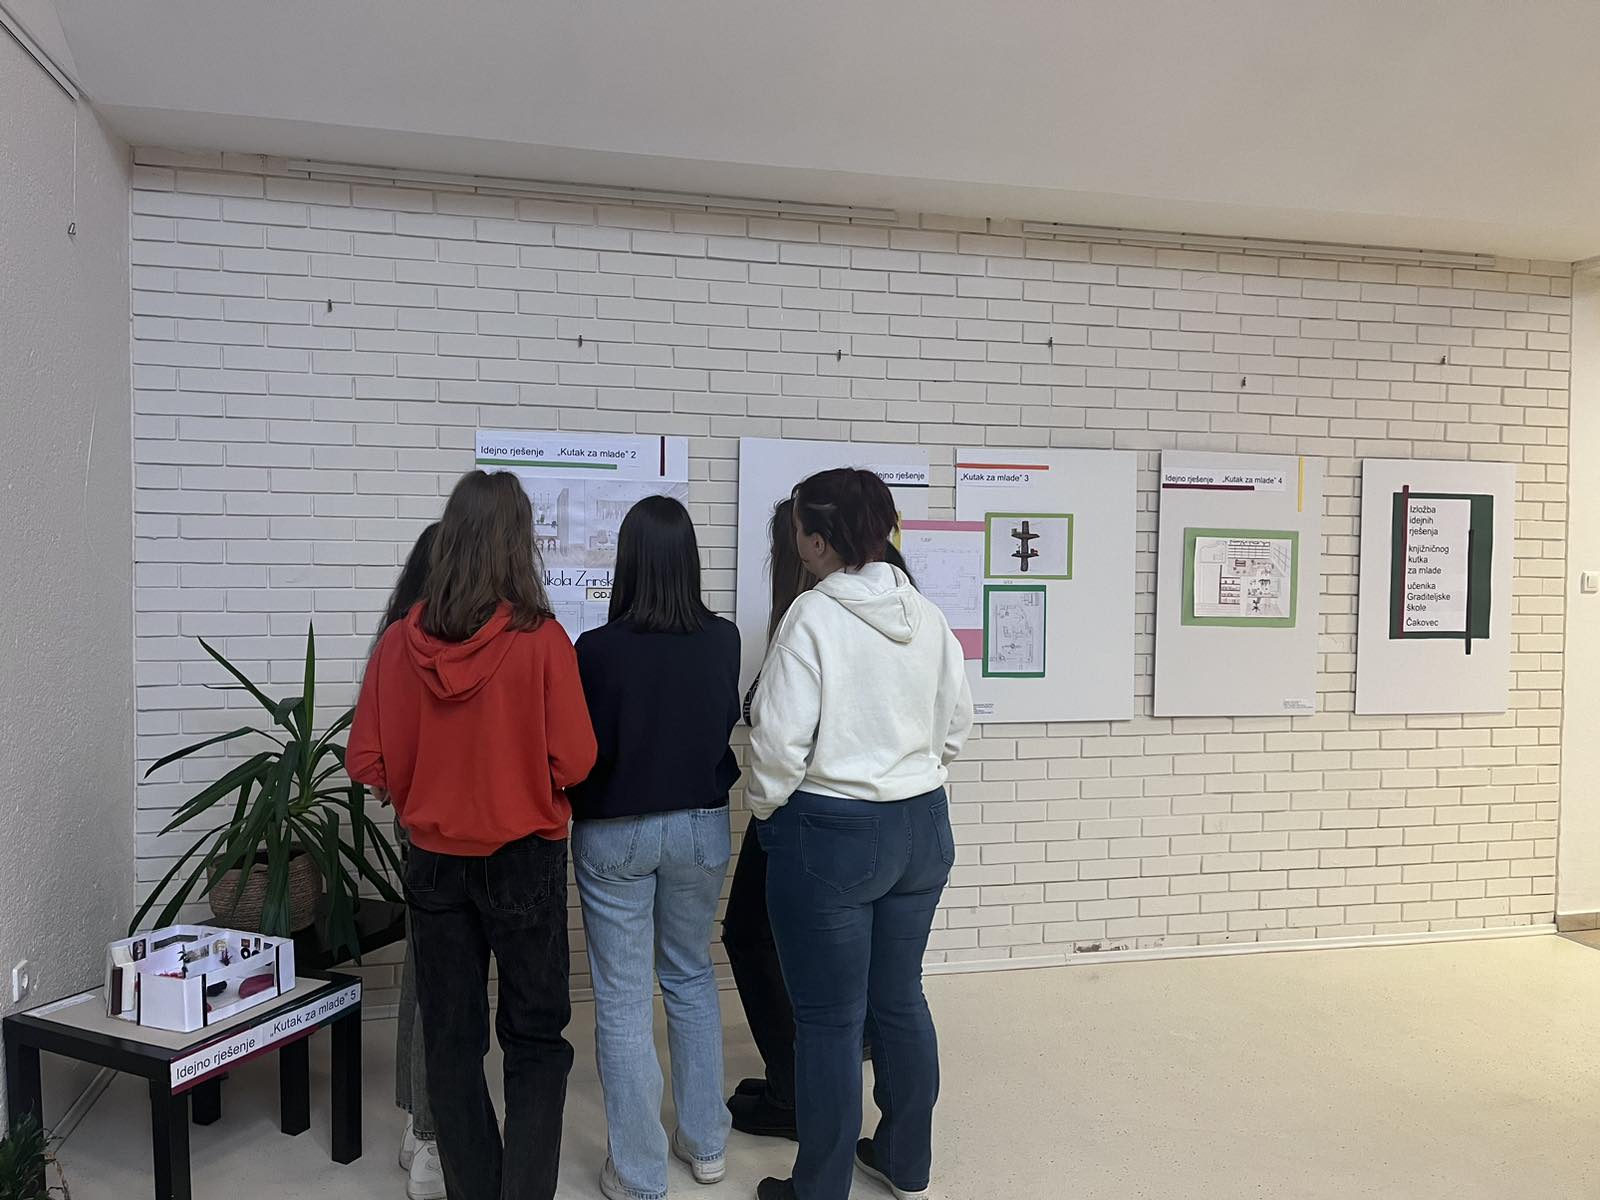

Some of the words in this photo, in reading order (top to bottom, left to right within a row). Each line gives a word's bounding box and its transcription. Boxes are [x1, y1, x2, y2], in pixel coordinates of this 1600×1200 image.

[480, 445, 508, 456] Idejno
[510, 446, 545, 457] rješenje
[587, 449, 598, 458] za
[631, 450, 637, 459] 2
[876, 471, 894, 480] ejno
[895, 471, 925, 481] rješenje
[1024, 474, 1029, 482] 3
[1165, 474, 1186, 484] Idejno
[1187, 475, 1214, 485] rješenje
[1409, 505, 1437, 514] Izložba
[1409, 516, 1434, 526] idejnih
[1409, 527, 1439, 537] rješenja
[1408, 544, 1450, 555] knjižničnog
[1408, 555, 1429, 564] kutka
[1407, 567, 1417, 575] za
[1418, 566, 1442, 575] mlade
[575, 570, 614, 587] Zrinsk
[1407, 582, 1437, 590] učenika
[1406, 592, 1451, 602] Graditeljske
[1406, 603, 1427, 612] škole
[1406, 616, 1439, 627] Čakovec
[176, 1057, 211, 1080] Idejno
[213, 1037, 256, 1066] rješenje
[304, 1008, 317, 1022] za
[350, 989, 356, 1001] 5
